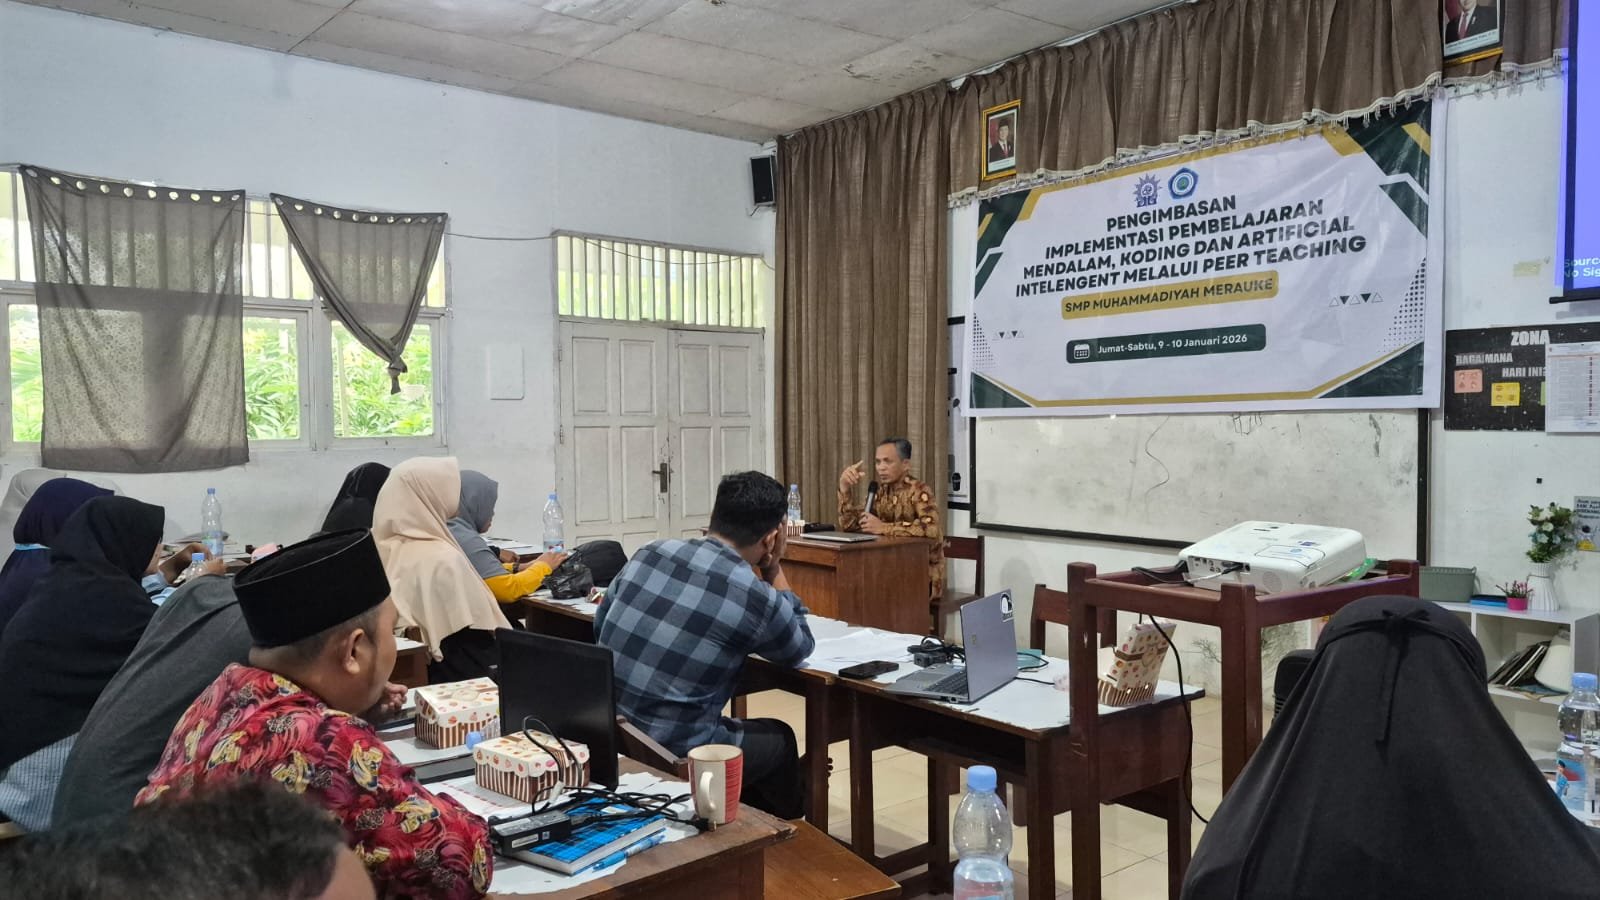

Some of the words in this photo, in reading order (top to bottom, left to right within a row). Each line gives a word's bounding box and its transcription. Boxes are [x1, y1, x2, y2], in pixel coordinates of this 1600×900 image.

[1045, 227, 1164, 260] IMPLEMENTASI
[1168, 199, 1324, 241] PEMBELAJARAN
[1107, 195, 1236, 232] PENGIMBASAN
[1023, 255, 1116, 280] MENDALAM,
[1120, 242, 1190, 267] KODING
[1194, 236, 1234, 256] DAN
[1237, 215, 1355, 249] ARTIFICIAL
[1015, 271, 1120, 298] INTELENGENT
[1123, 260, 1198, 284] MELALUI
[1202, 253, 1250, 273] PEER
[1253, 235, 1367, 266] TEACHING
[1065, 301, 1090, 313] SMP
[1093, 289, 1200, 310] MUHAMMADIYAH
[1203, 278, 1273, 297] MERAUKE
[1097, 342, 1157, 354] Jumat-Sabtu,
[1158, 340, 1165, 350] 9
[1172, 339, 1183, 348] 10
[1184, 335, 1221, 347] Januari
[1222, 334, 1248, 345] 2026
[1511, 330, 1550, 346] ZONA
[1455, 353, 1513, 366] BAGAIMANA
[1502, 367, 1526, 378] HARI
